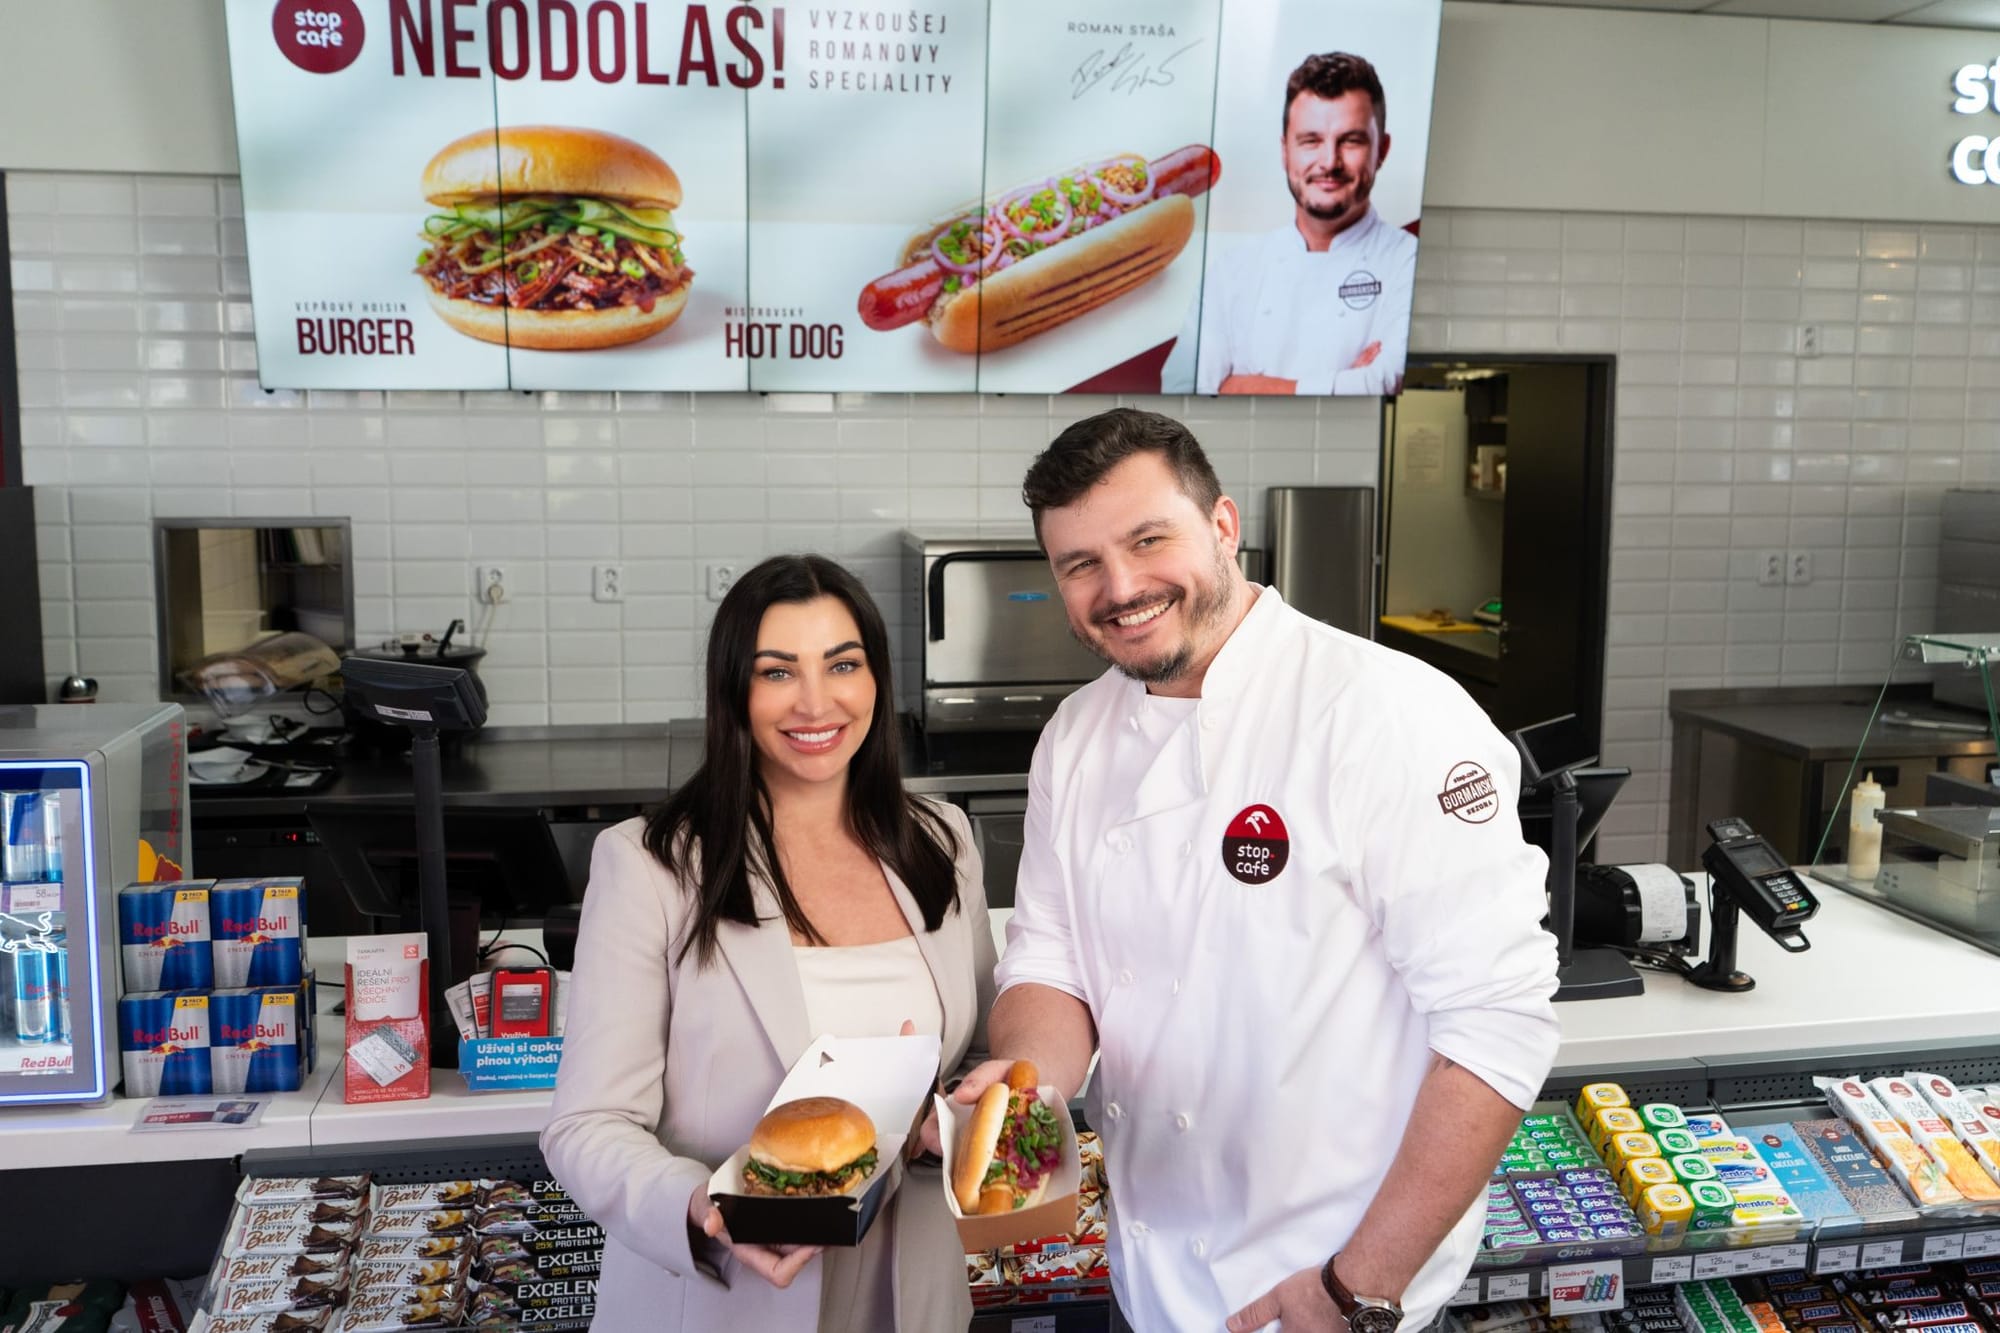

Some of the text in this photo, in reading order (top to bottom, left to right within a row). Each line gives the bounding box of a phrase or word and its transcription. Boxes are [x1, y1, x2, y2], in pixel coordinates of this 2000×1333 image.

[809, 9, 947, 34] VYZKOUŠEJ
[1067, 22, 1176, 37] ROMAN STAŠA
[296, 28, 344, 48] cafe
[809, 40, 939, 63] ROMANOVY
[809, 70, 952, 93] SPECIALITY
[296, 318, 415, 355] BURGER
[725, 322, 844, 359] HOT DOG
[1442, 774, 1496, 810] GURMÁNSK
[1236, 860, 1270, 877] cafe
[134, 919, 200, 937] Red Bull
[222, 916, 288, 933] Red Bull
[133, 1026, 200, 1044] Red Bull
[221, 1023, 285, 1040] Red Bull
[477, 1043, 515, 1055] Užívej
[517, 1042, 528, 1053] si
[21, 1055, 72, 1069] Red Bull
[476, 1056, 511, 1068] plnou
[1515, 1180, 1542, 1190] Orbit
[1566, 1171, 1592, 1183] Orbit
[384, 1184, 431, 1207] Bar!
[1525, 1188, 1551, 1199] Orbit
[1574, 1183, 1601, 1195] Orbit
[1532, 1201, 1558, 1212] Orbit
[1581, 1197, 1608, 1209] Orbit
[253, 1204, 302, 1225] Bar!
[372, 1211, 421, 1233] Bar!
[1539, 1214, 1566, 1226] Orbit
[1590, 1211, 1617, 1223] Orbit
[246, 1227, 296, 1249] Bar!
[1547, 1228, 1574, 1239] Orbit
[1598, 1225, 1625, 1237] Orbit
[363, 1238, 414, 1258] Bar!
[555, 1239, 591, 1248] PROTEIN
[1557, 1247, 1594, 1259] Orbit
[230, 1256, 281, 1281] Bar!
[357, 1264, 407, 1289] Bar!
[232, 1281, 283, 1309] Bar!
[551, 1296, 591, 1305] PROTEIN
[1555, 1289, 1568, 1298] 22
[1637, 1305, 1674, 1318] HALLS
[1911, 1302, 1965, 1321] SNICKERS
[1644, 1319, 1682, 1331] HALLS
